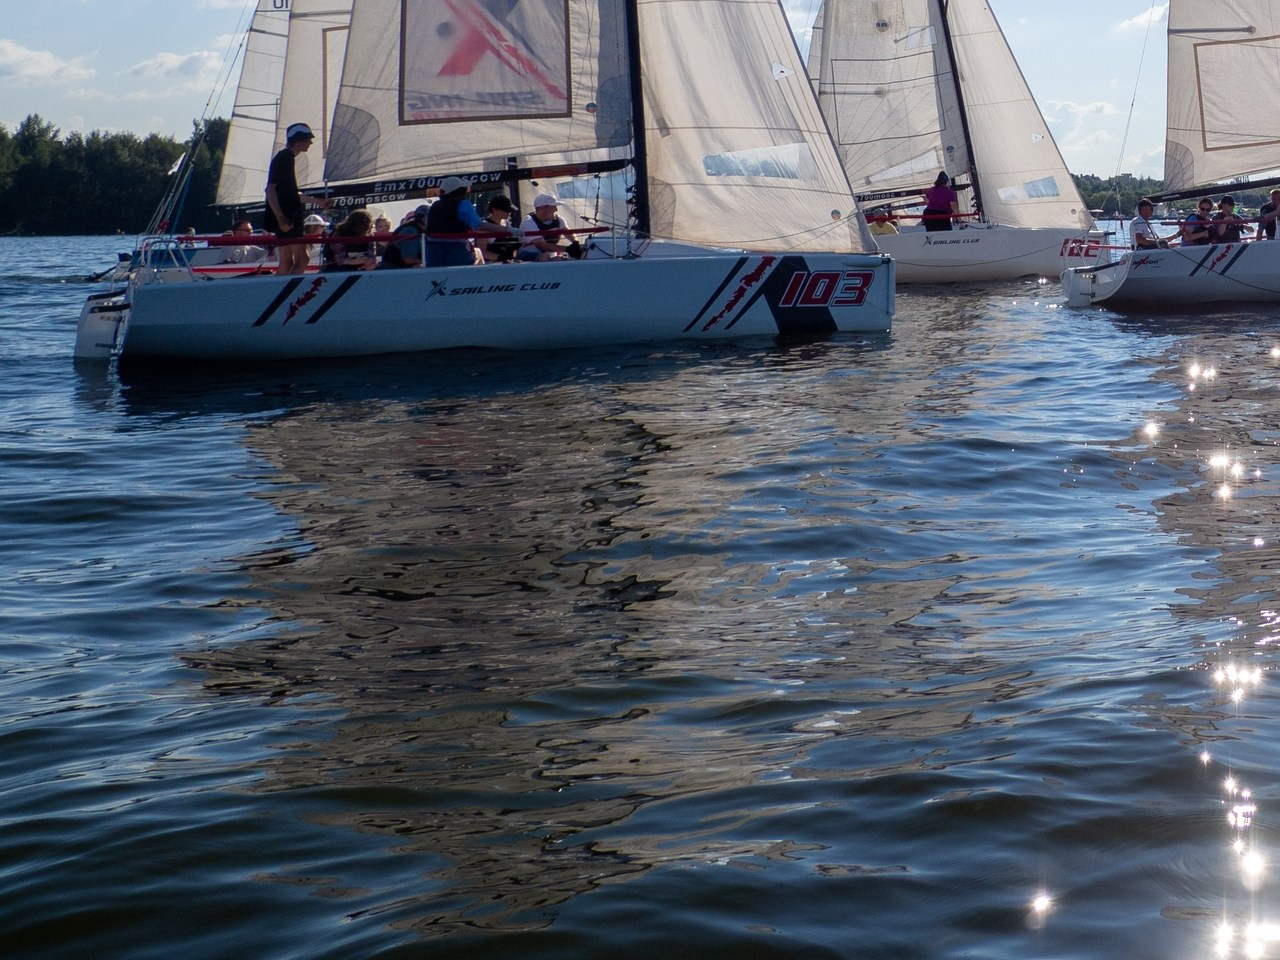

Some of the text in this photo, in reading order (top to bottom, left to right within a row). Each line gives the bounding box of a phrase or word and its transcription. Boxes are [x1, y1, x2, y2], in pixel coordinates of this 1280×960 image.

[449, 284, 518, 296] SAILING
[519, 282, 562, 292] CLUB
[779, 270, 876, 307] 103
